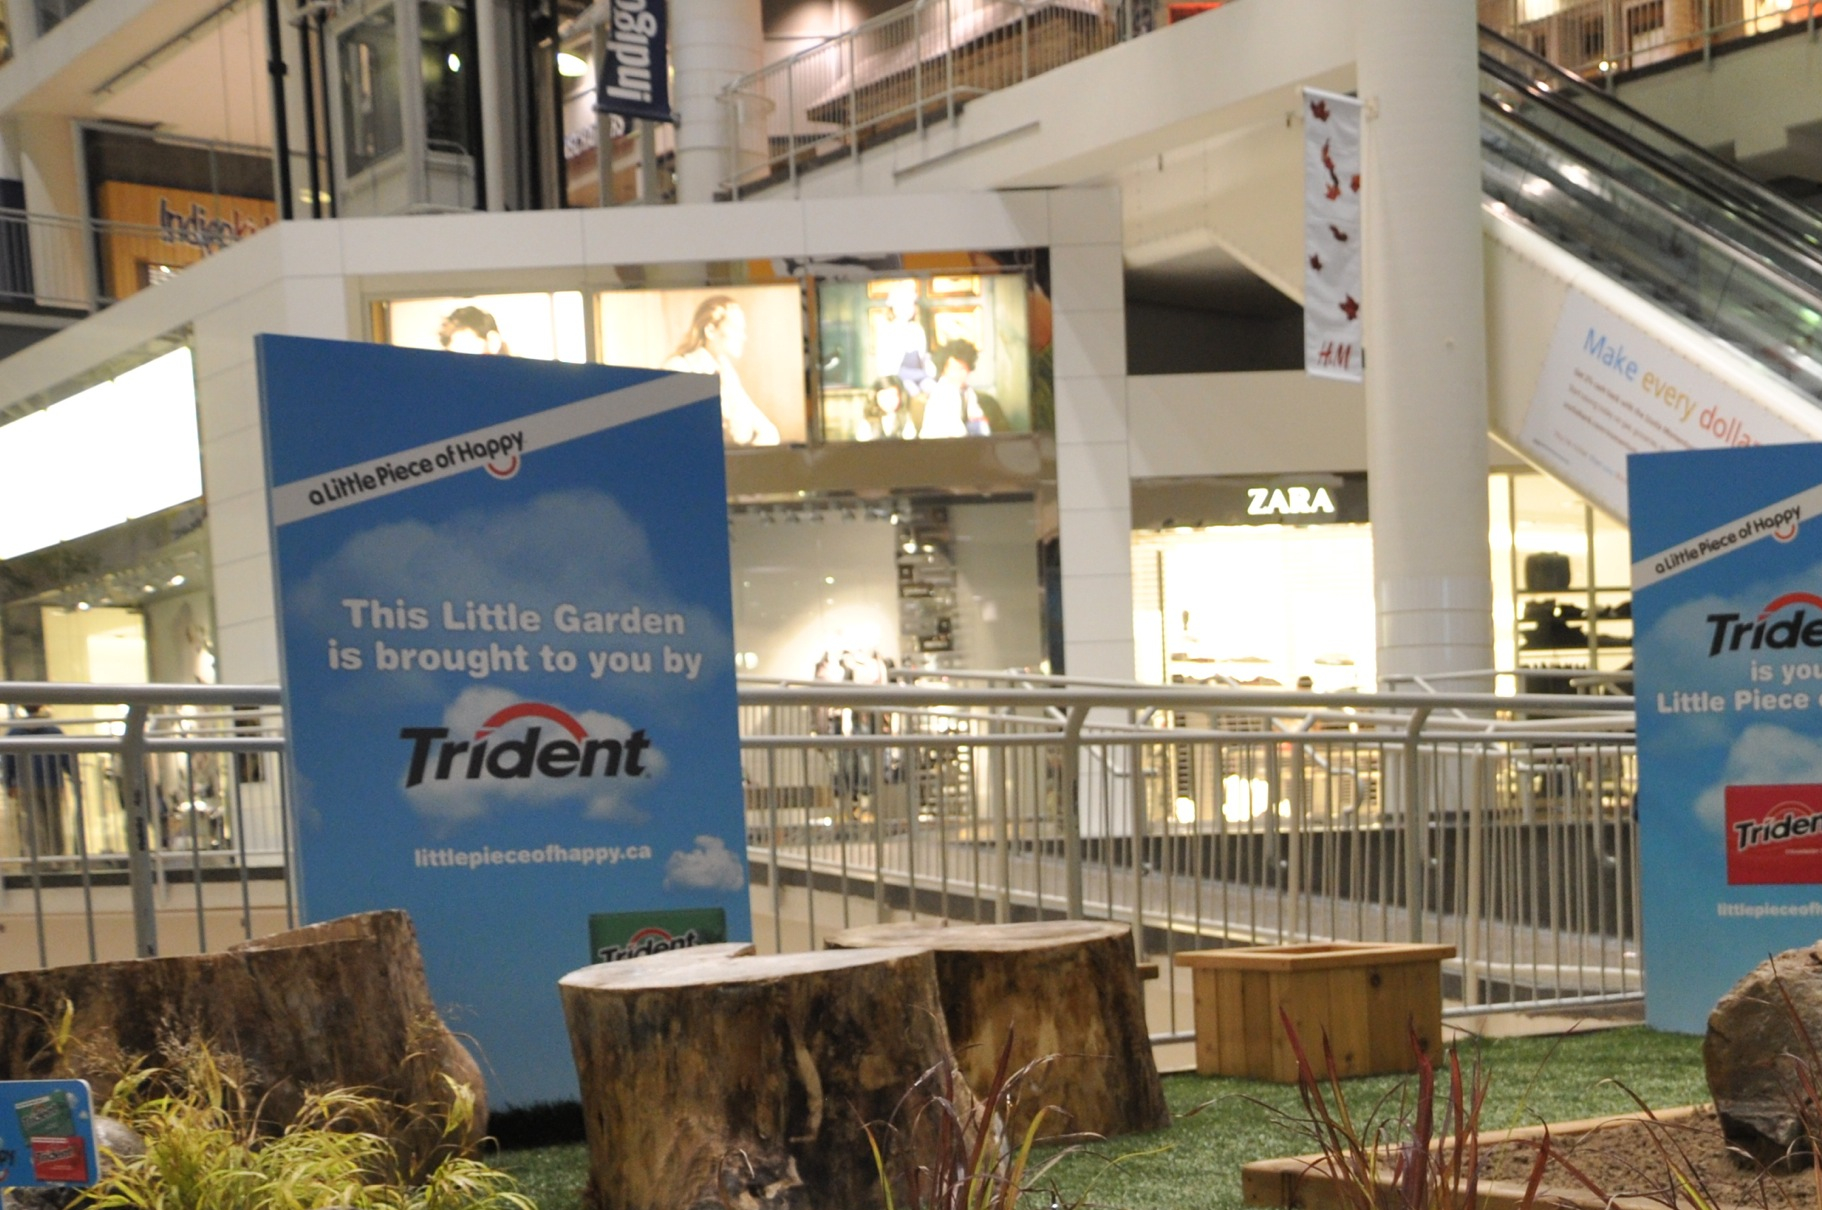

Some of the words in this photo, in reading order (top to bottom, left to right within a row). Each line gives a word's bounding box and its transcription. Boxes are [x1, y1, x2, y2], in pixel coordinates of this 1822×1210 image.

[1582, 327, 1639, 382] Make
[1641, 368, 1698, 424] every
[308, 489, 326, 506] a
[323, 473, 378, 502] Little
[375, 457, 434, 487] Piece
[435, 443, 457, 469] of
[456, 431, 524, 463] Happy
[1248, 486, 1335, 516] ZARA
[1664, 547, 1698, 571] Little
[1699, 533, 1737, 556] Piece
[1739, 521, 1752, 538] of
[1753, 505, 1801, 534] Happy
[342, 598, 430, 632] This
[442, 601, 541, 634] Little
[554, 605, 686, 637] Garden
[328, 640, 362, 671] is
[375, 641, 529, 679] brought
[538, 644, 577, 674] to
[588, 651, 653, 679] you
[662, 645, 703, 680] by
[1750, 659, 1775, 682] is
[1656, 687, 1725, 714] Little
[1734, 685, 1811, 712] Piece
[400, 726, 651, 789] Trident
[414, 841, 652, 871] littlepieceofhappy.ca
